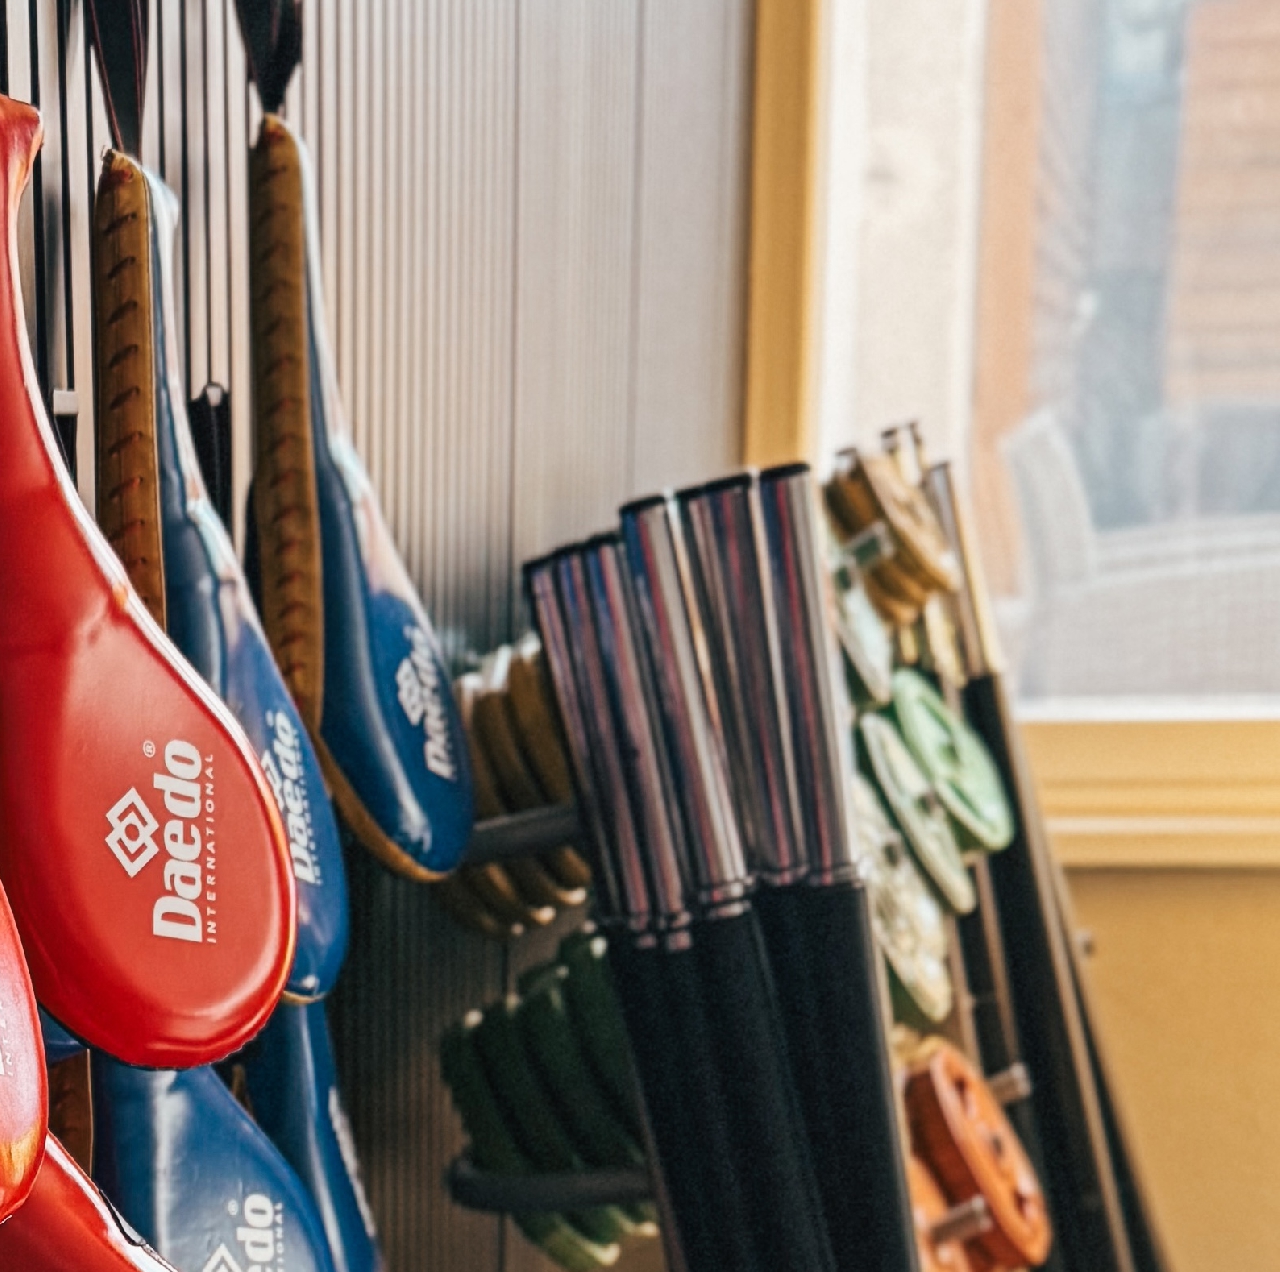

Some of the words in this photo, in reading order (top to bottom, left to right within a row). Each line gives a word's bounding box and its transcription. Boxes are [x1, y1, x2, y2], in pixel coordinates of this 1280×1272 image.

[153, 739, 203, 943] Daedo
[205, 754, 217, 943] INTERNATIONAL
[274, 709, 317, 884] Daedo
